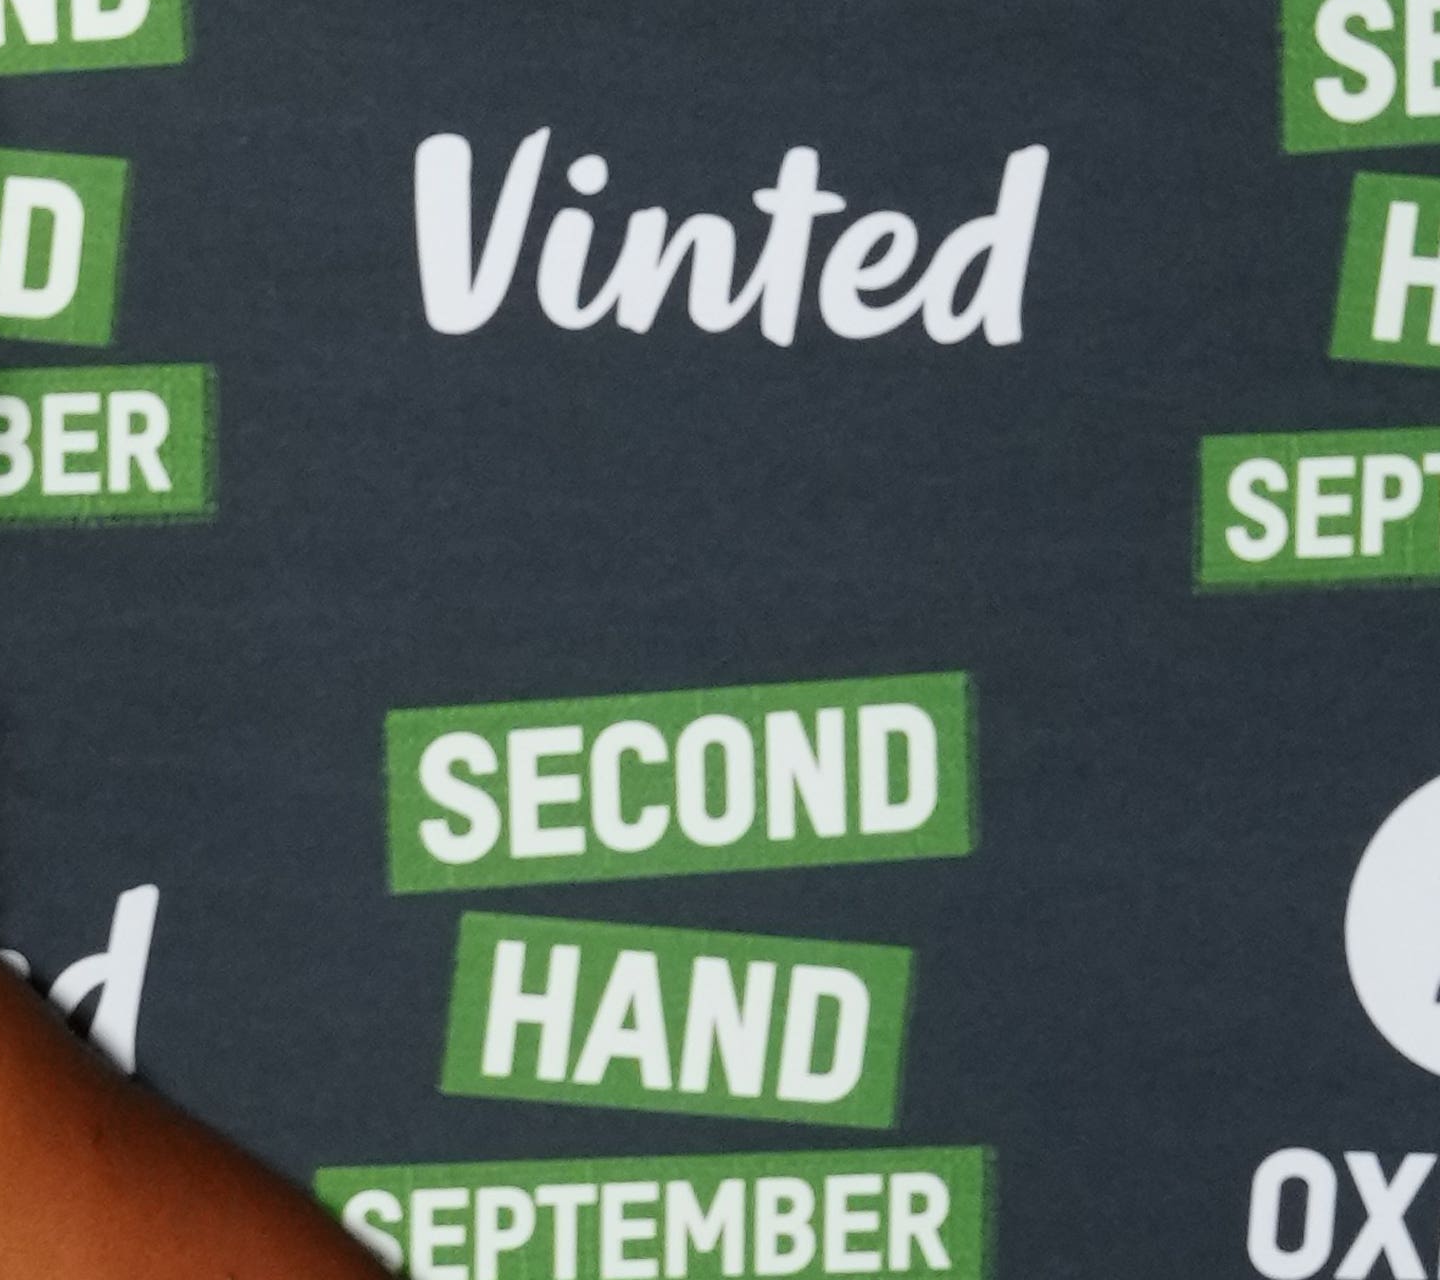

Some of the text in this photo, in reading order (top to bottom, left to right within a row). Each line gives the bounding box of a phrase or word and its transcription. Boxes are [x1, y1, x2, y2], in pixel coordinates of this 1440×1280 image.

[415, 128, 1049, 346] Vinted
[419, 703, 938, 864] SECOND
[483, 940, 870, 1103] HAND
